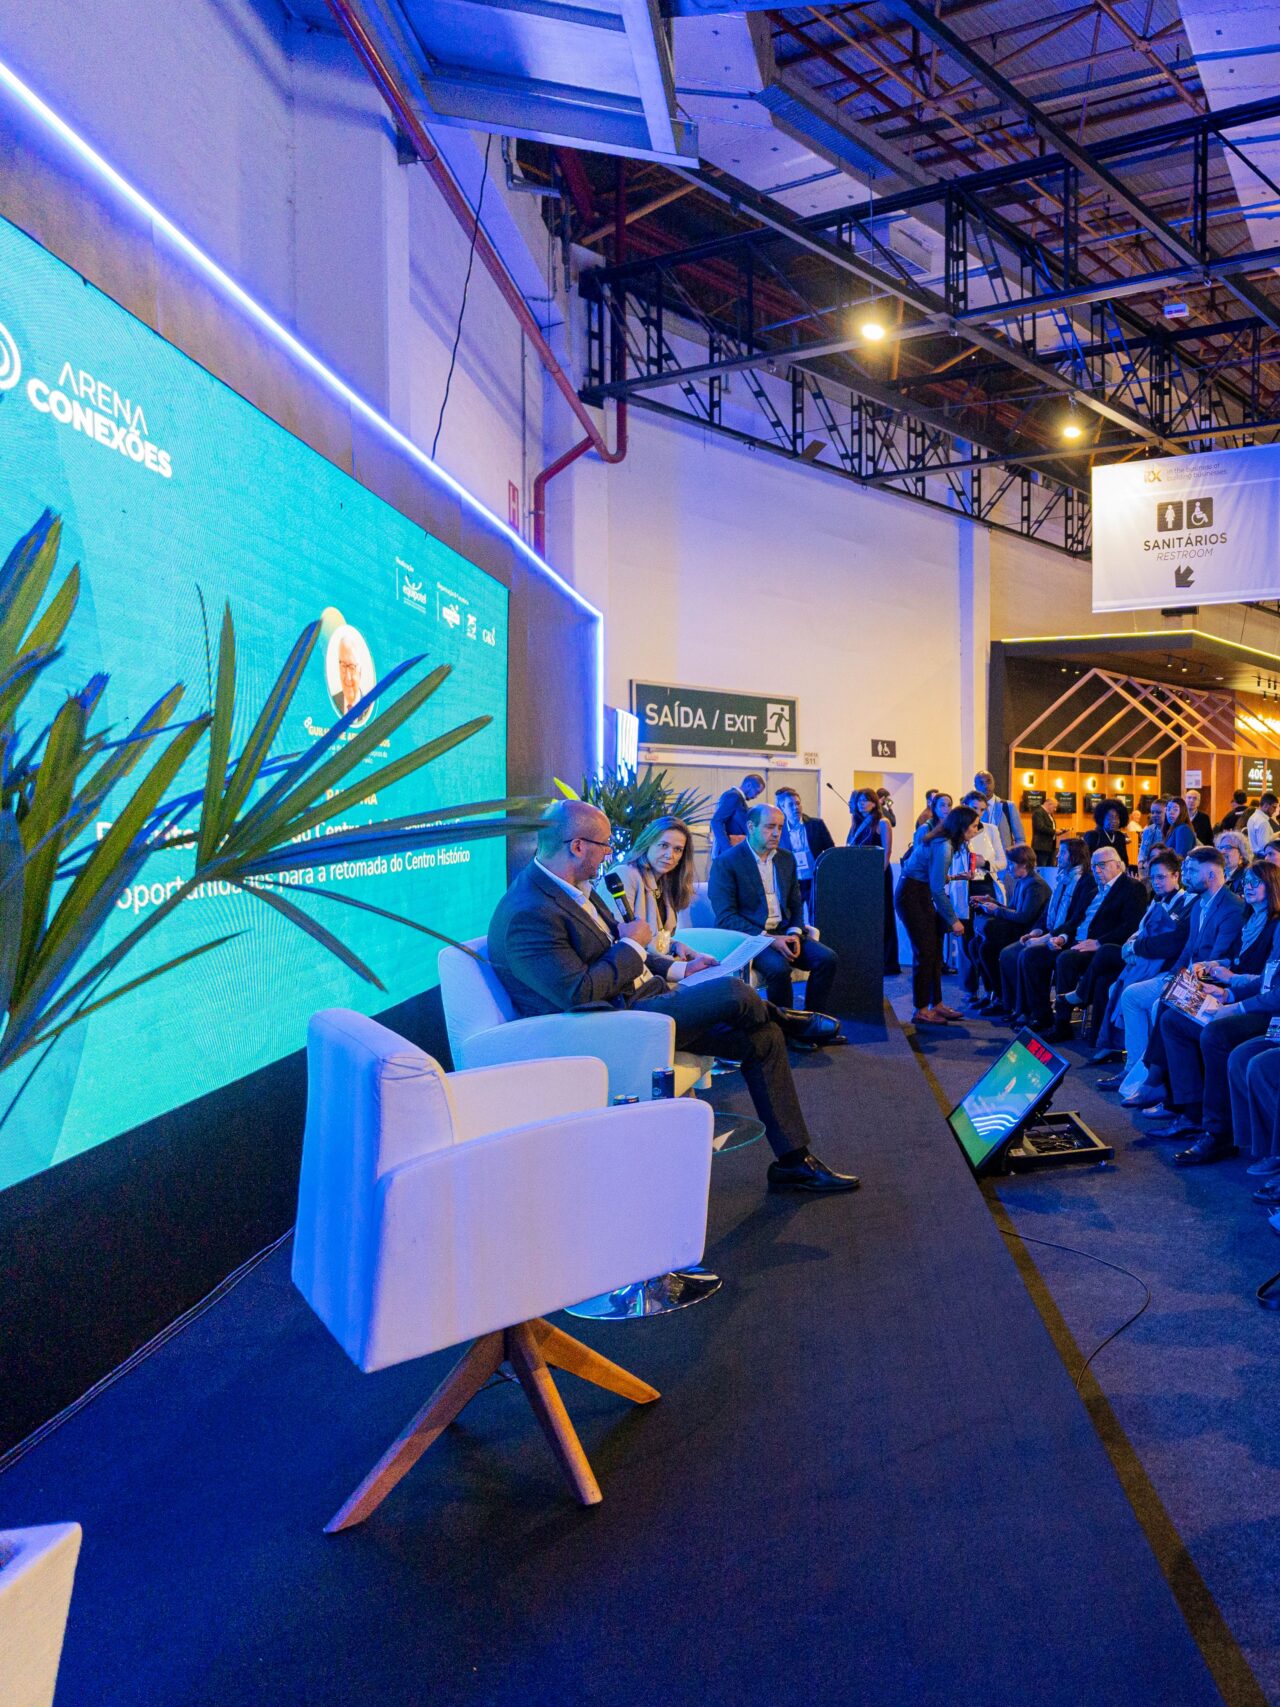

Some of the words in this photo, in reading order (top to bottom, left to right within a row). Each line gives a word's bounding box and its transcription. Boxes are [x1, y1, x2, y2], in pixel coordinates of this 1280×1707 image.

[58, 361, 149, 436] ARENA
[26, 377, 173, 479] CONEXÕES
[1143, 532, 1228, 552] SANITÁRIOS
[1156, 548, 1214, 562] RESTROOM
[645, 701, 707, 730] SAÍDA
[724, 714, 757, 733] EXIT
[278, 865, 314, 893] para
[318, 865, 327, 883] a
[330, 855, 388, 880] retomada
[390, 853, 403, 873] do
[405, 851, 435, 871] Centro
[437, 847, 471, 867] Histórico
